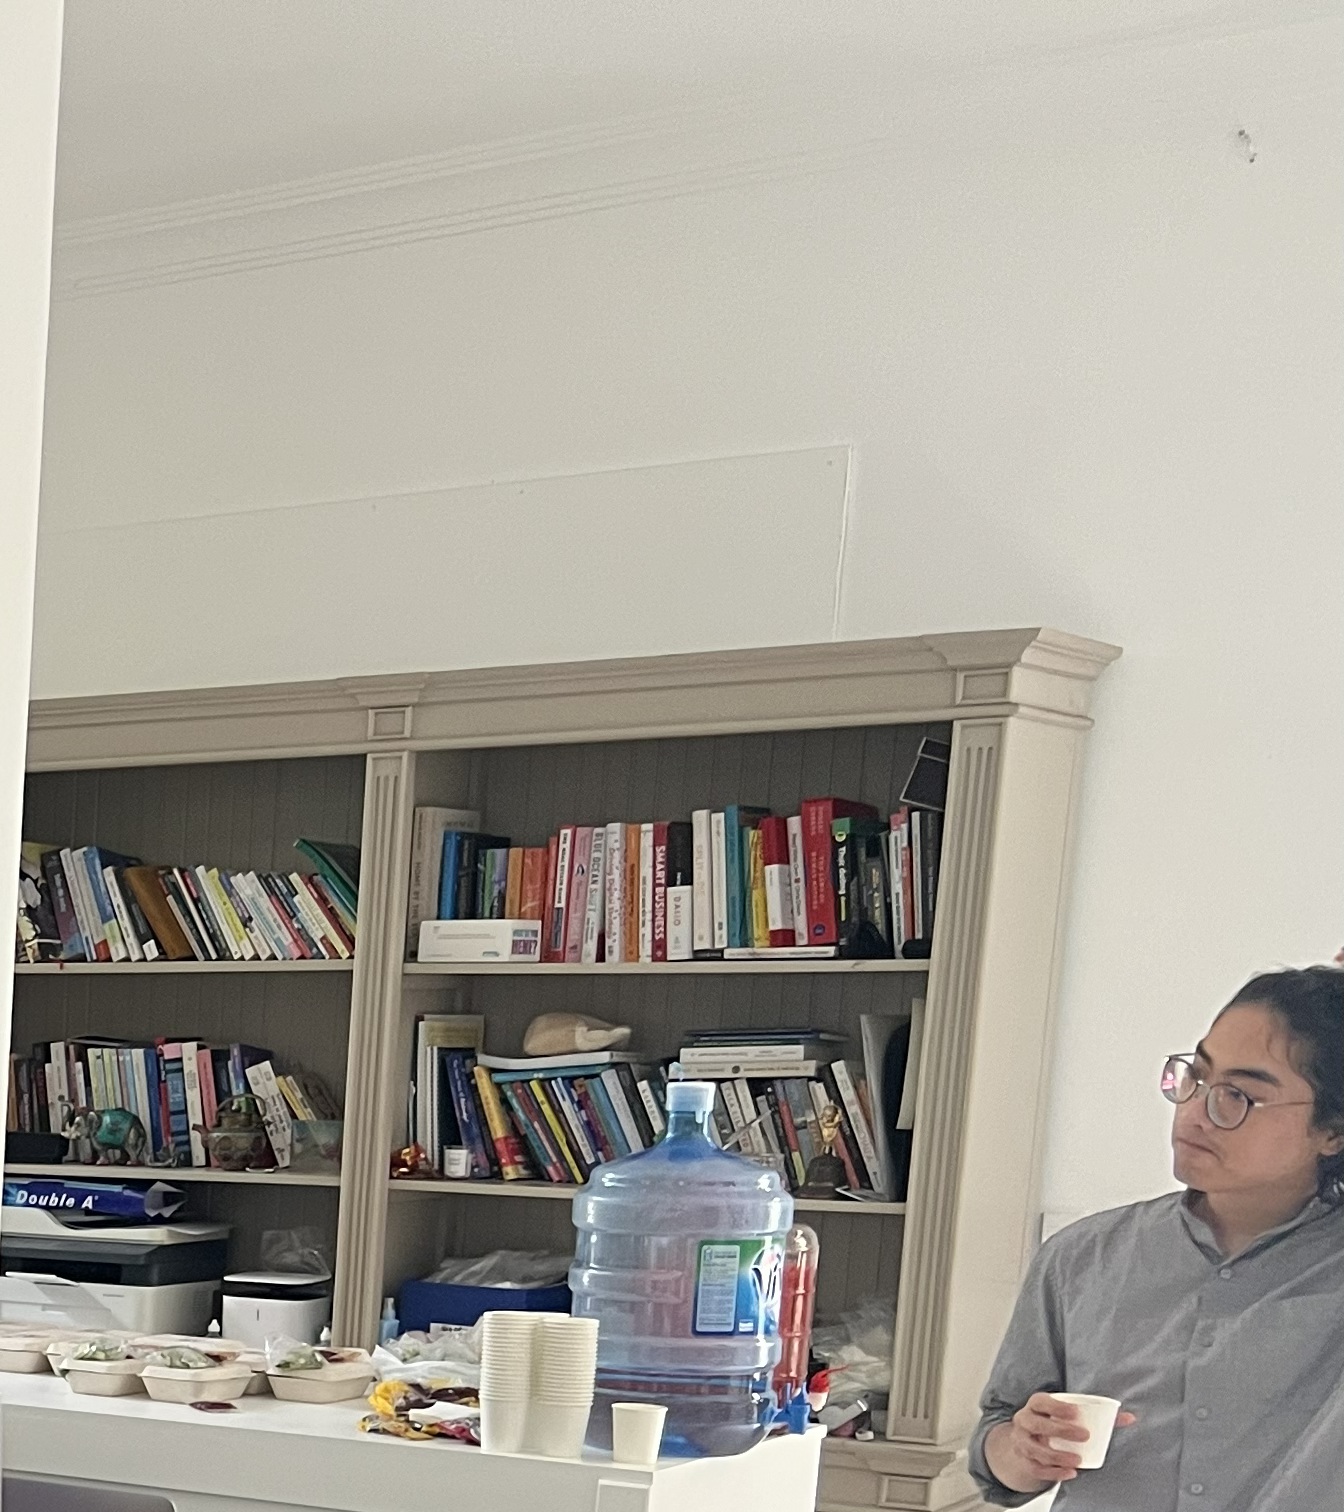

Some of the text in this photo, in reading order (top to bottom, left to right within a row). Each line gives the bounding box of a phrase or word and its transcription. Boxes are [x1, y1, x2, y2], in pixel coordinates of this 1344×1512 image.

[593, 832, 603, 853] BLUE
[590, 856, 601, 885] OCEAN
[655, 845, 666, 940] SMART BUSINESS
[673, 895, 681, 926] DALIO
[15, 1189, 93, 1210] Double A
